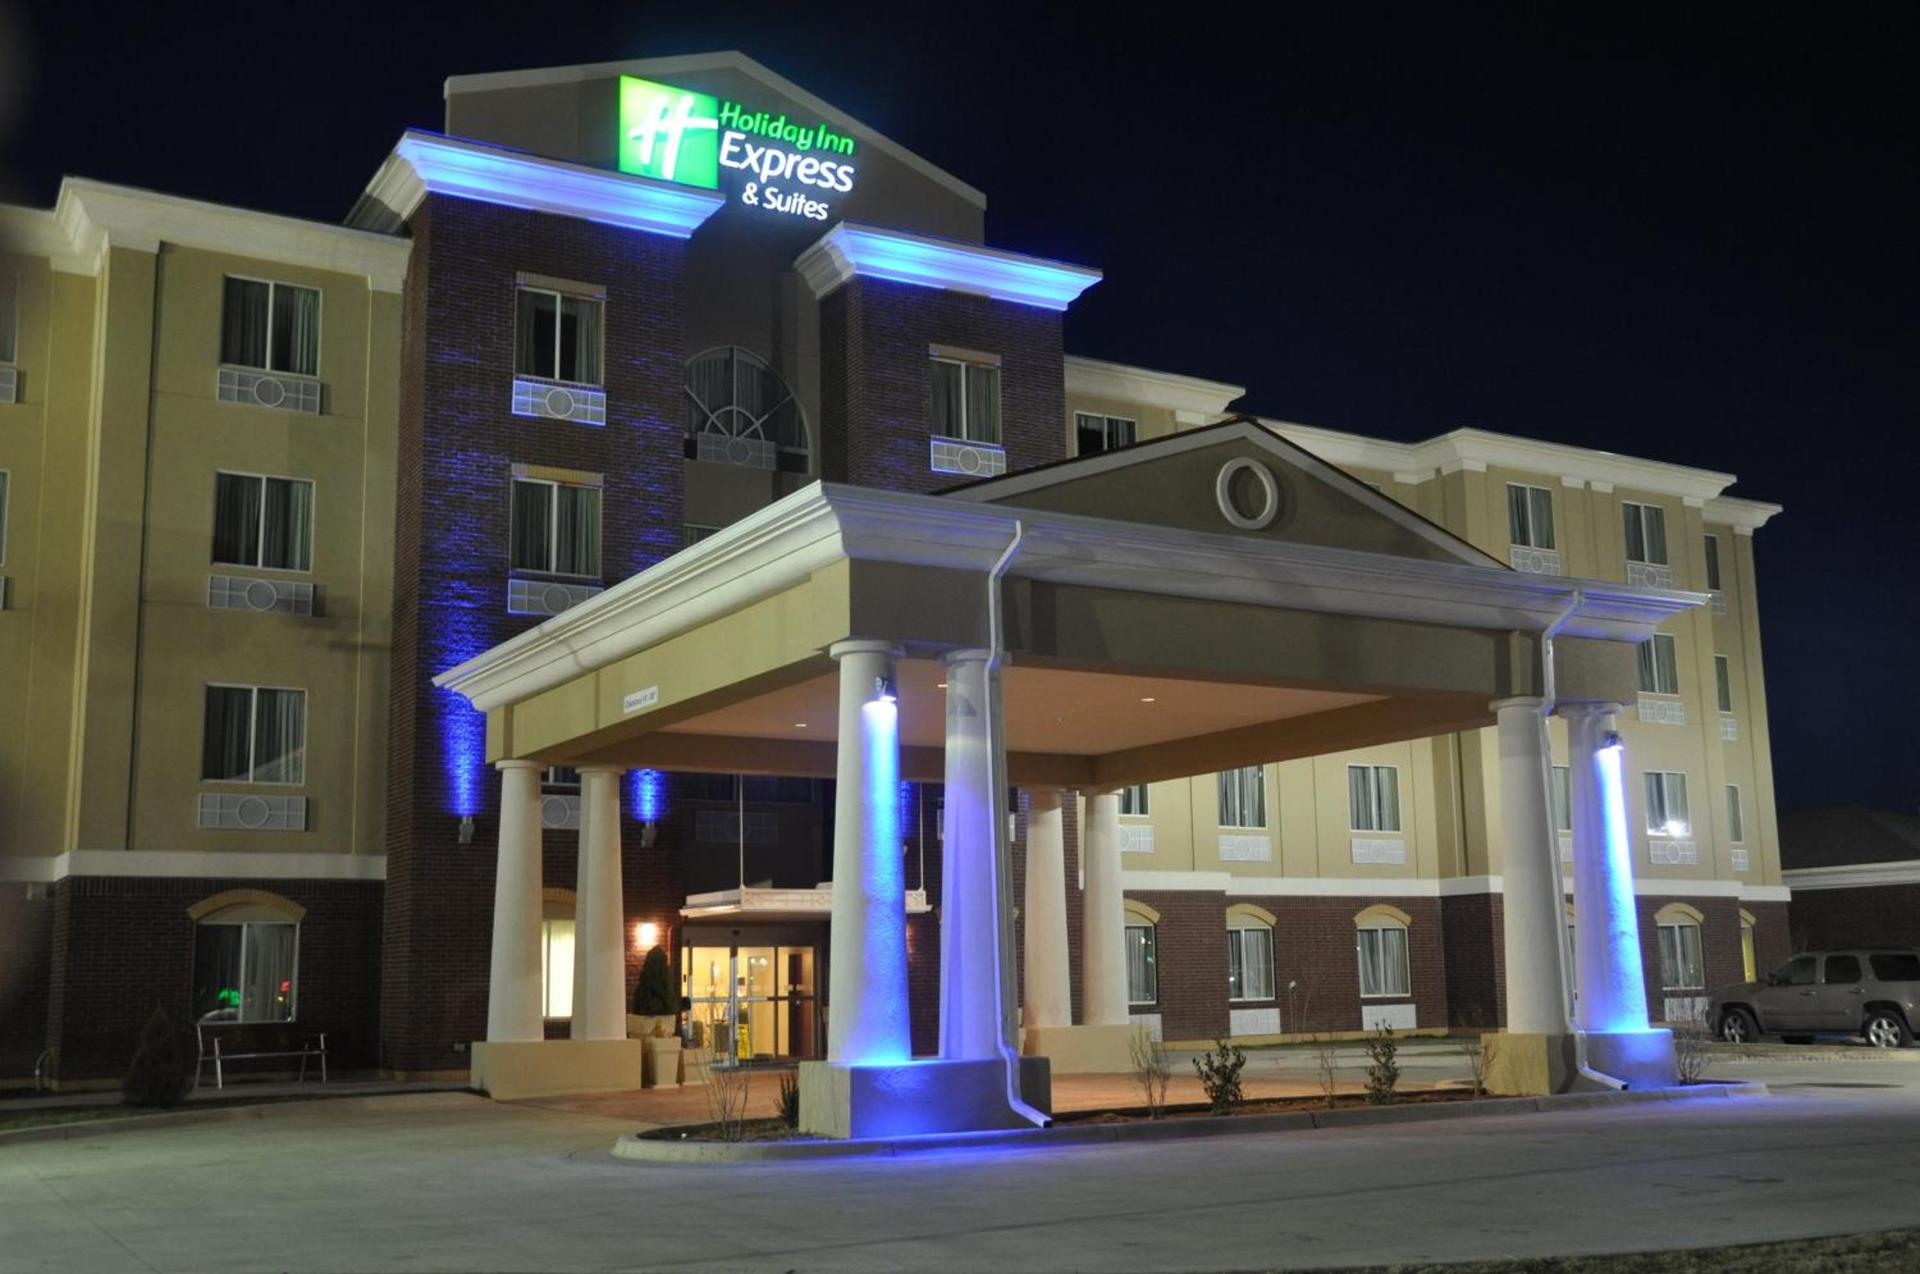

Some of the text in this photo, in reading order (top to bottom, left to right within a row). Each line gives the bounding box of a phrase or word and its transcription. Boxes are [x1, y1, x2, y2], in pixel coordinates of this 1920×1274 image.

[720, 102, 855, 155] Holiday Inn
[719, 130, 855, 193] Express
[742, 182, 829, 221] & Suites
